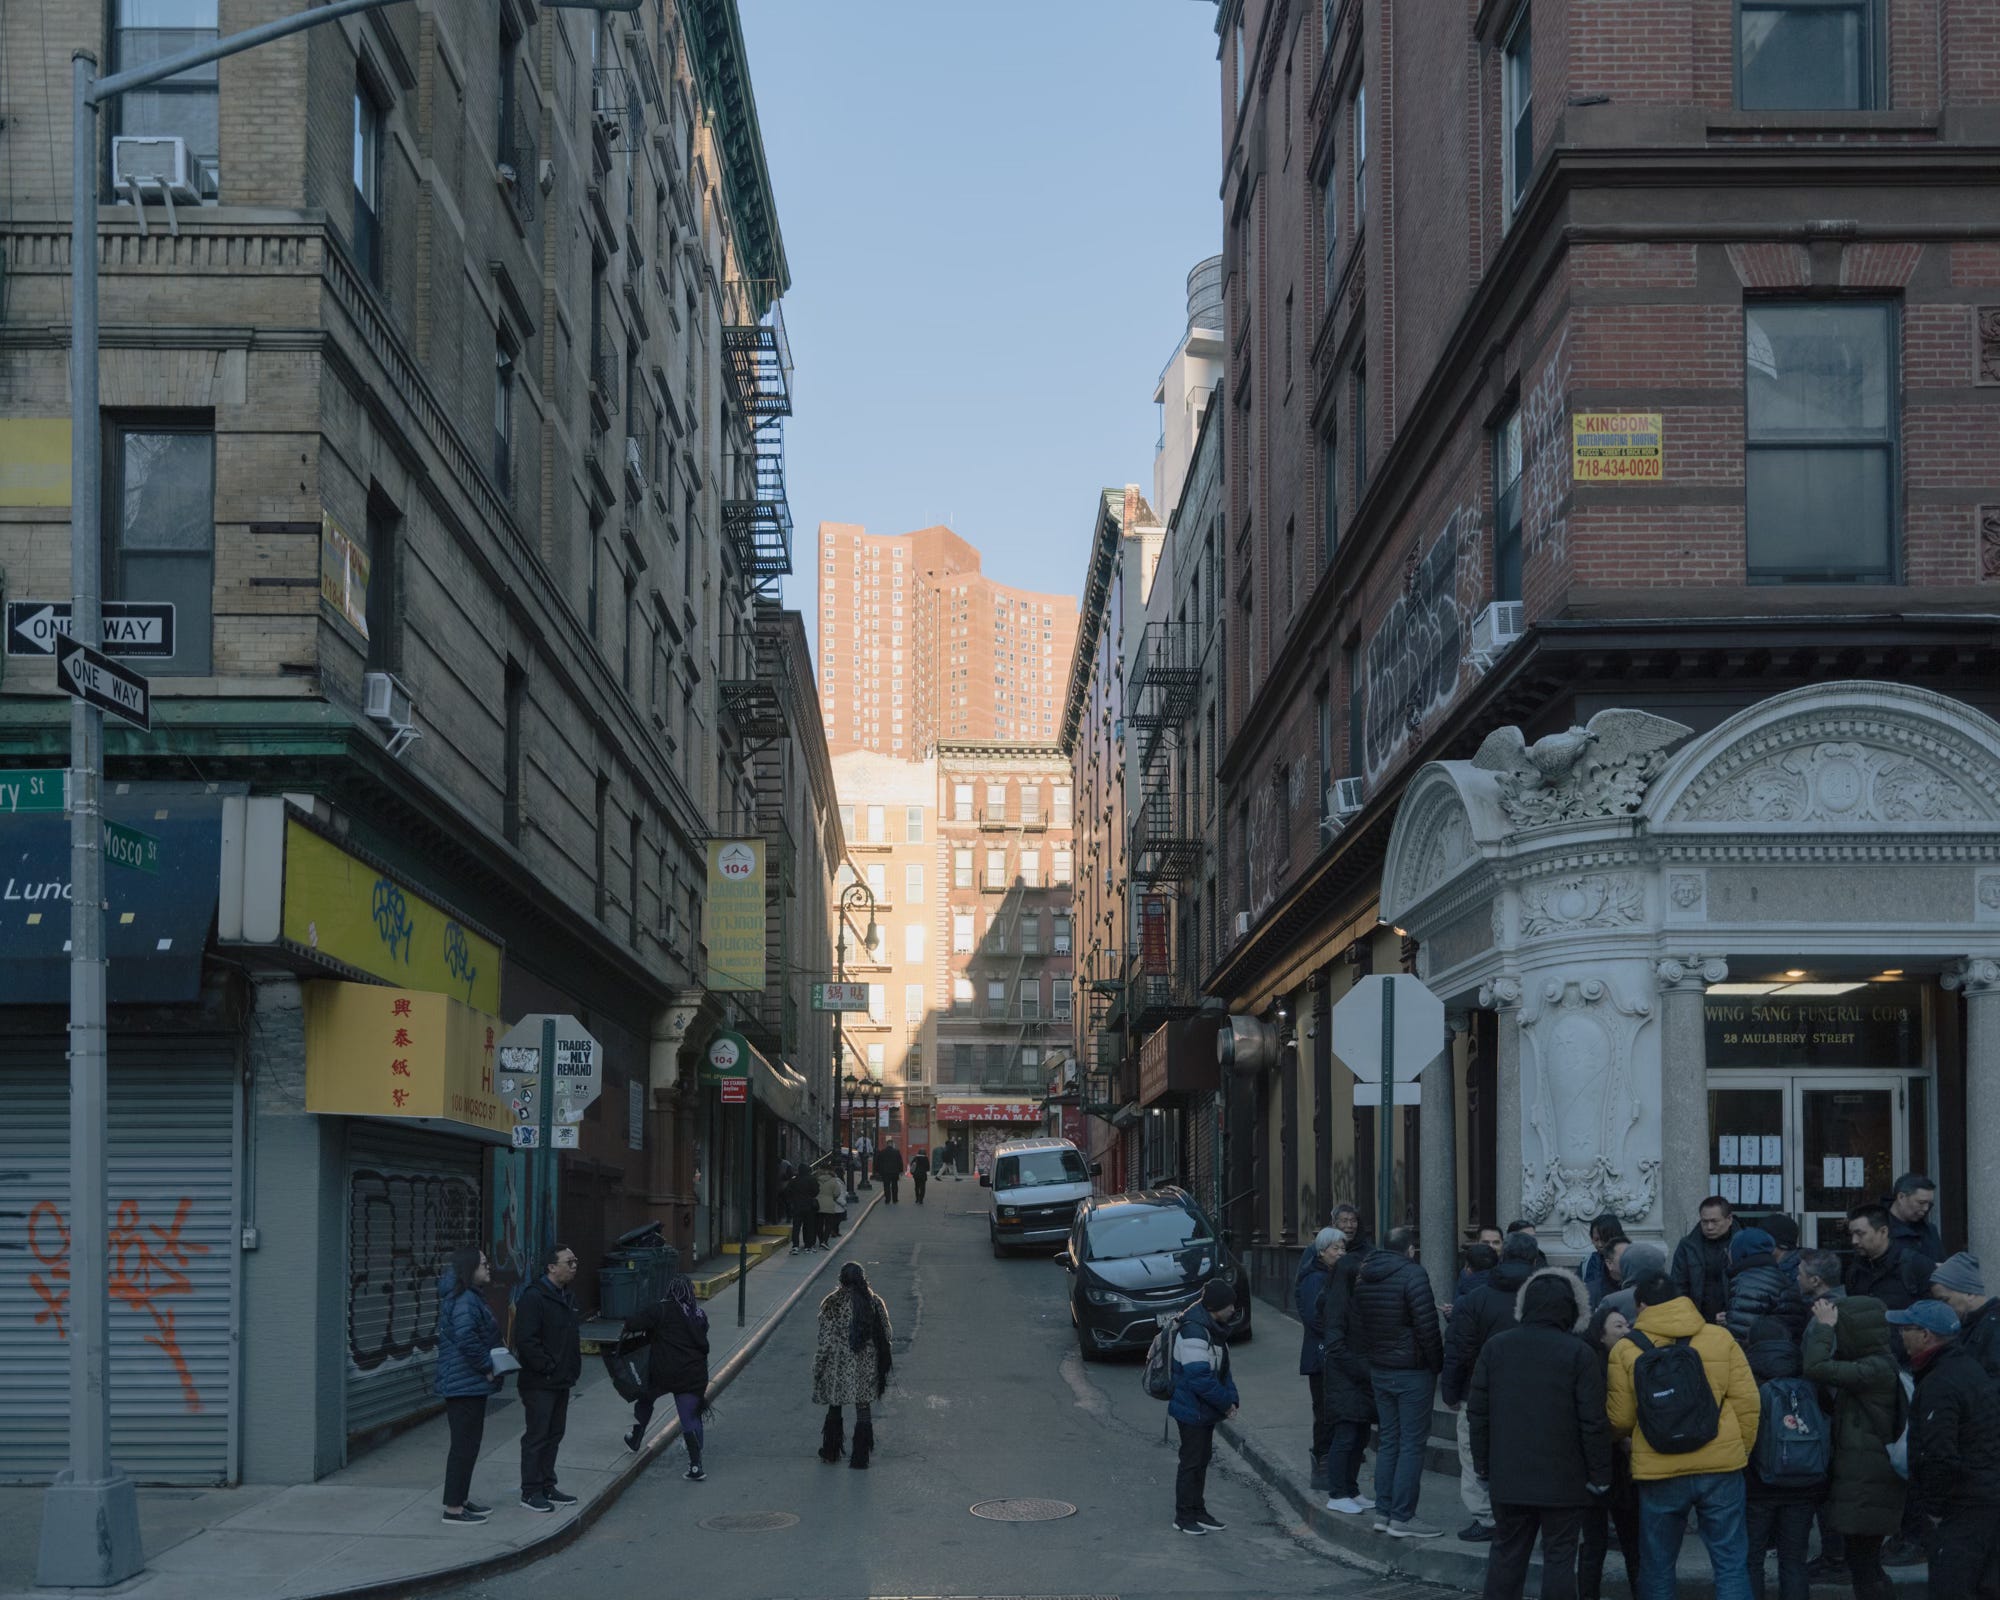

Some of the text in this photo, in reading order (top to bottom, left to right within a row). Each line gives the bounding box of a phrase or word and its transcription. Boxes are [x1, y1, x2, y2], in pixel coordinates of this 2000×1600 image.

[1586, 416, 1649, 432] KINGDOM
[1577, 459, 1659, 477] 718-434-0020
[103, 620, 151, 640] WAY
[72, 658, 138, 708] ONE WAY
[30, 776, 45, 794] St
[148, 841, 157, 861] St
[724, 864, 749, 874] 104
[1704, 1006, 1744, 1021] WING
[1752, 1006, 1791, 1022] SANG
[1799, 1006, 1864, 1021] FUNERAL
[557, 1040, 591, 1051] TRADES
[1723, 1033, 1855, 1044] 28 MULBERRY STREET
[714, 1056, 733, 1064] 104
[464, 1097, 487, 1119] MOSCO
[488, 1105, 496, 1120] ST
